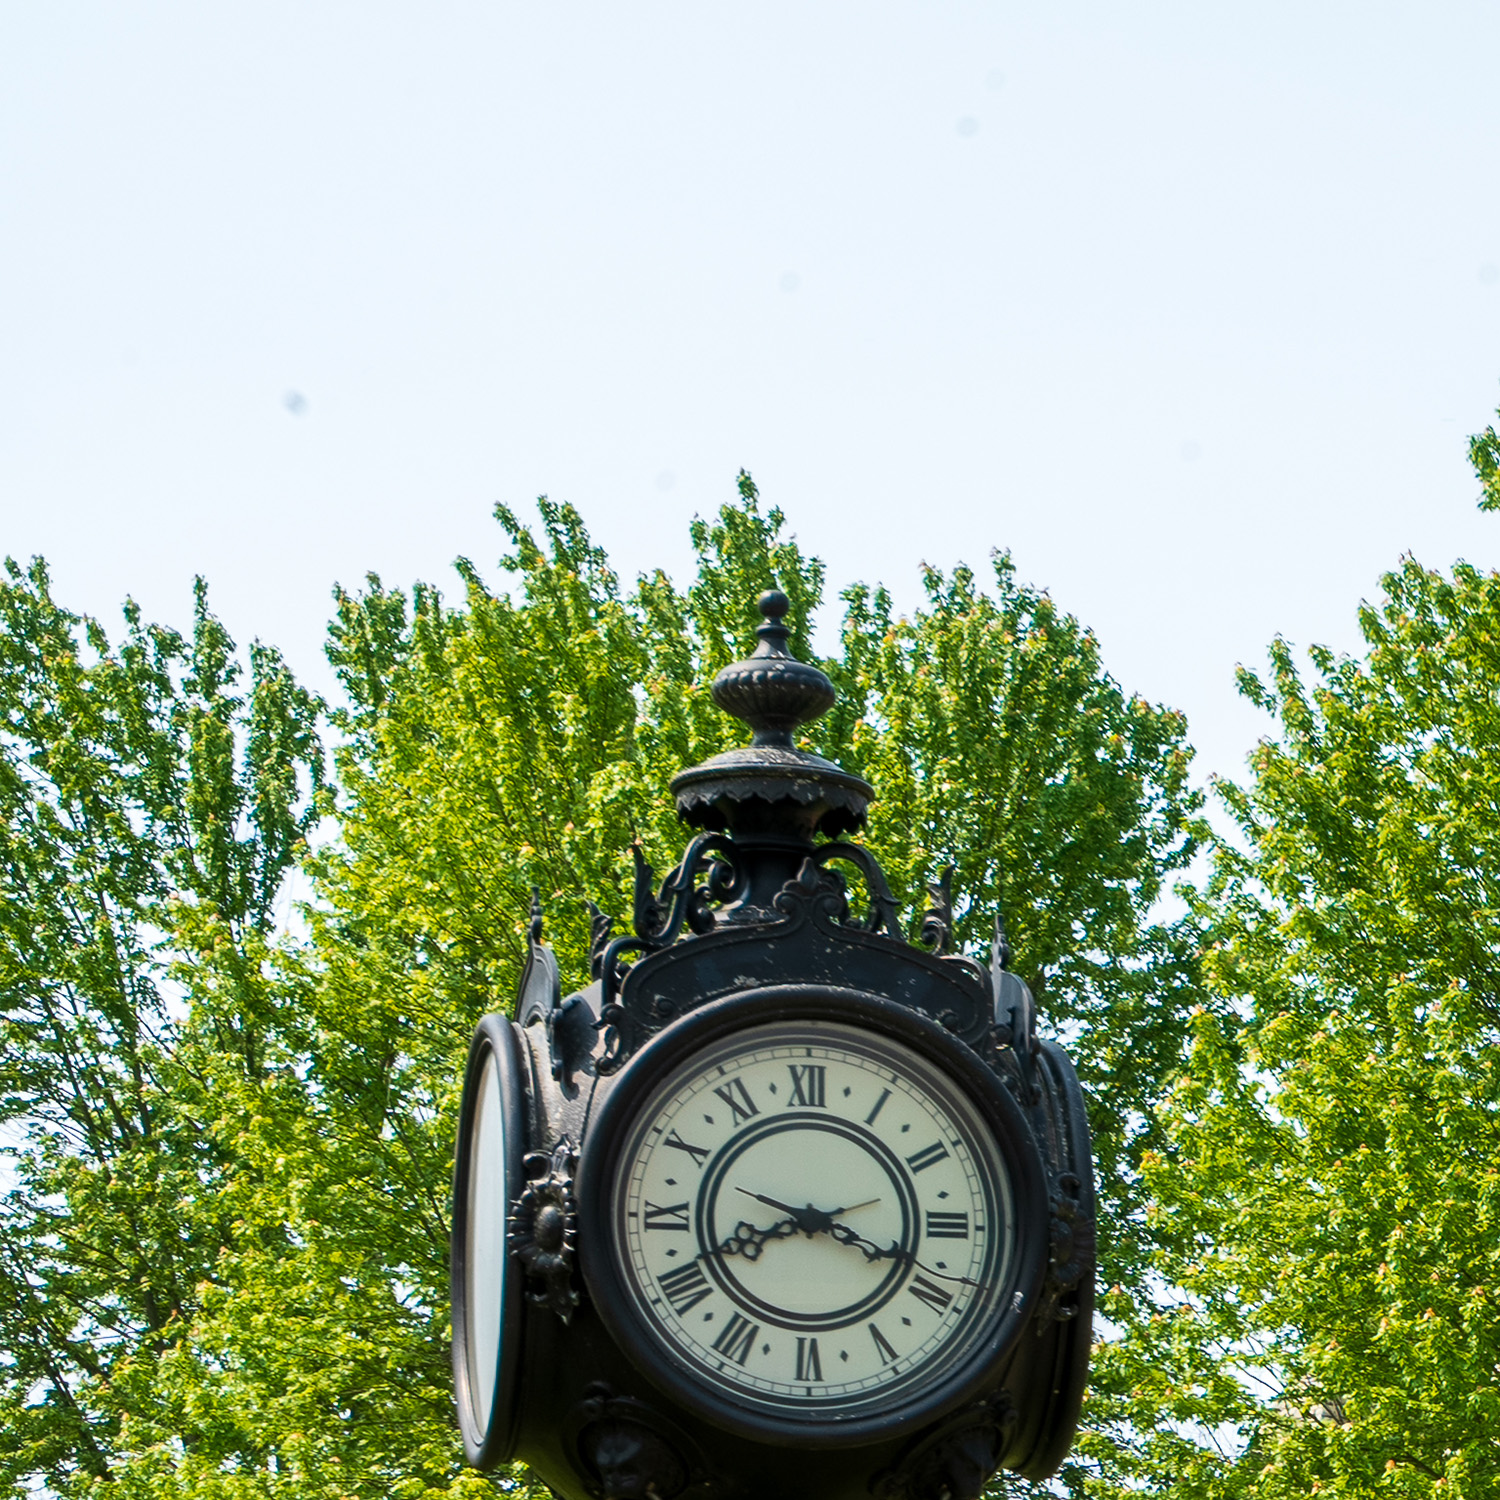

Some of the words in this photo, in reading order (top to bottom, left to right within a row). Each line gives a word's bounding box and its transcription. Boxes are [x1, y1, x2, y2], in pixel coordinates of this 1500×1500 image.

[713, 1076, 760, 1127] XI
[787, 1064, 826, 1108] XII
[864, 1088, 893, 1127] I
[663, 1128, 710, 1168] X
[905, 1140, 950, 1174] II
[644, 1200, 690, 1232] IX
[927, 1212, 968, 1239] III
[657, 1261, 713, 1318] VIII
[711, 1311, 760, 1367] VII
[795, 1336, 824, 1382] VI
[869, 1323, 900, 1366] V
